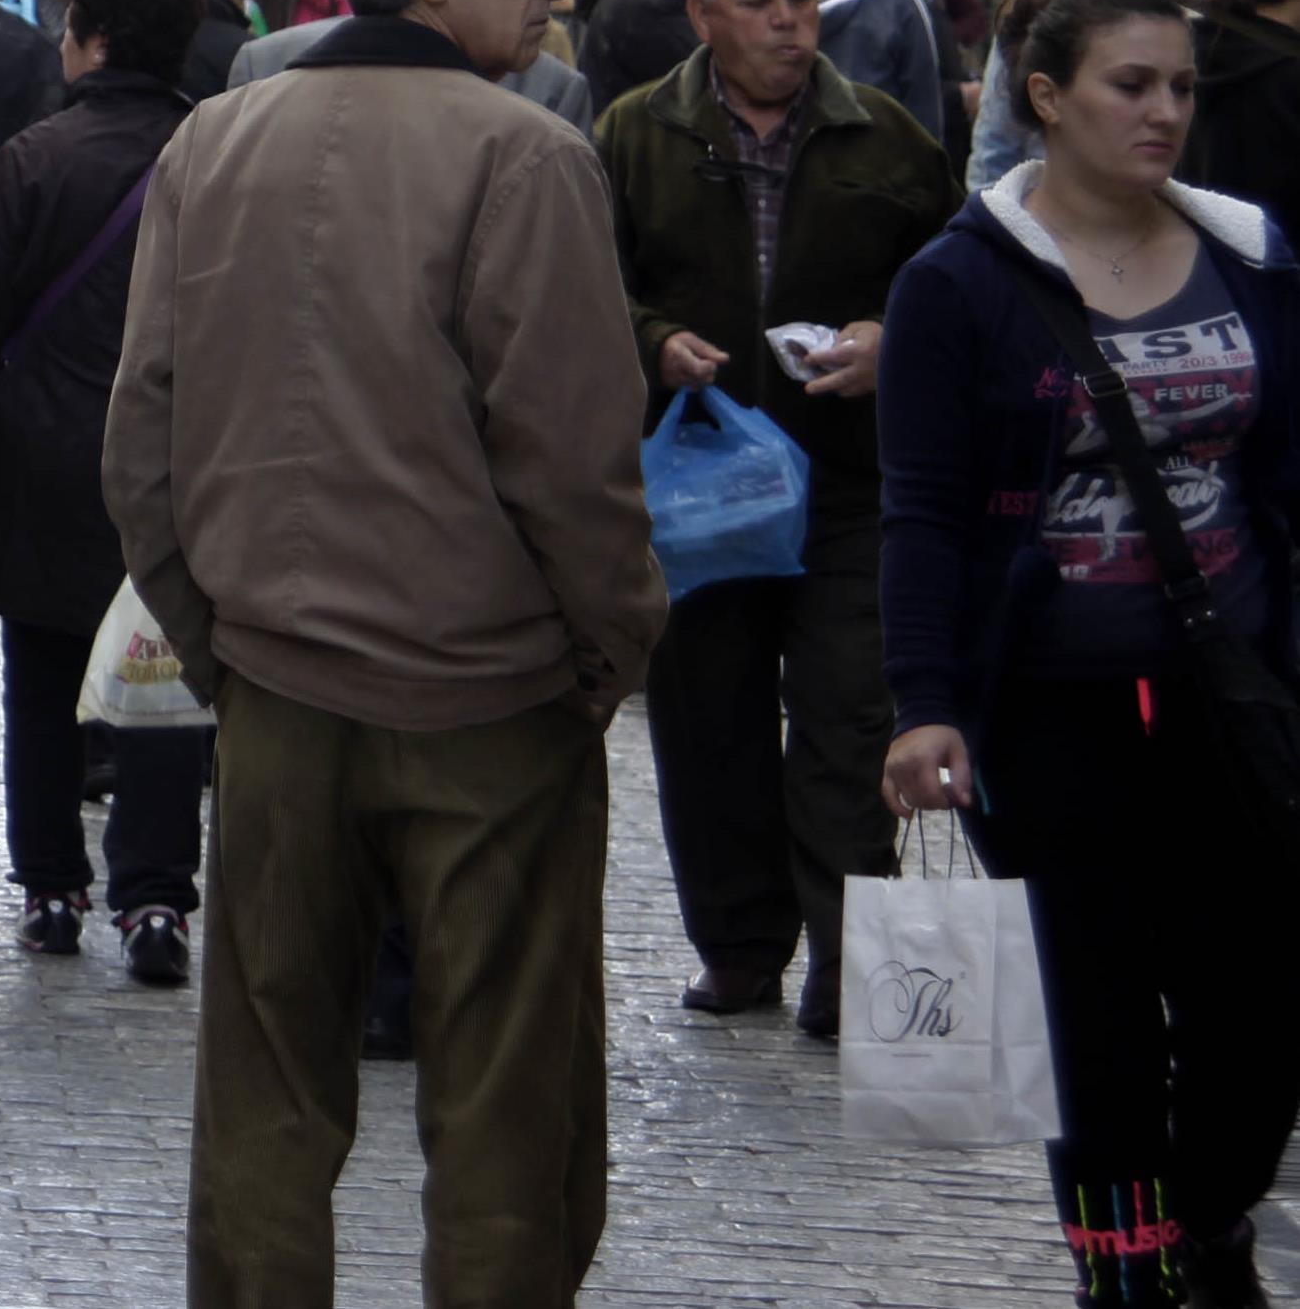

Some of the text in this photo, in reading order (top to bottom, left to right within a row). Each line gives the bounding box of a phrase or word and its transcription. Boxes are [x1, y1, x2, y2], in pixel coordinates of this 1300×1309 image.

[1121, 358, 1168, 372] PARTY
[1153, 382, 1230, 403] FEVER
[1087, 1219, 1186, 1258] music
